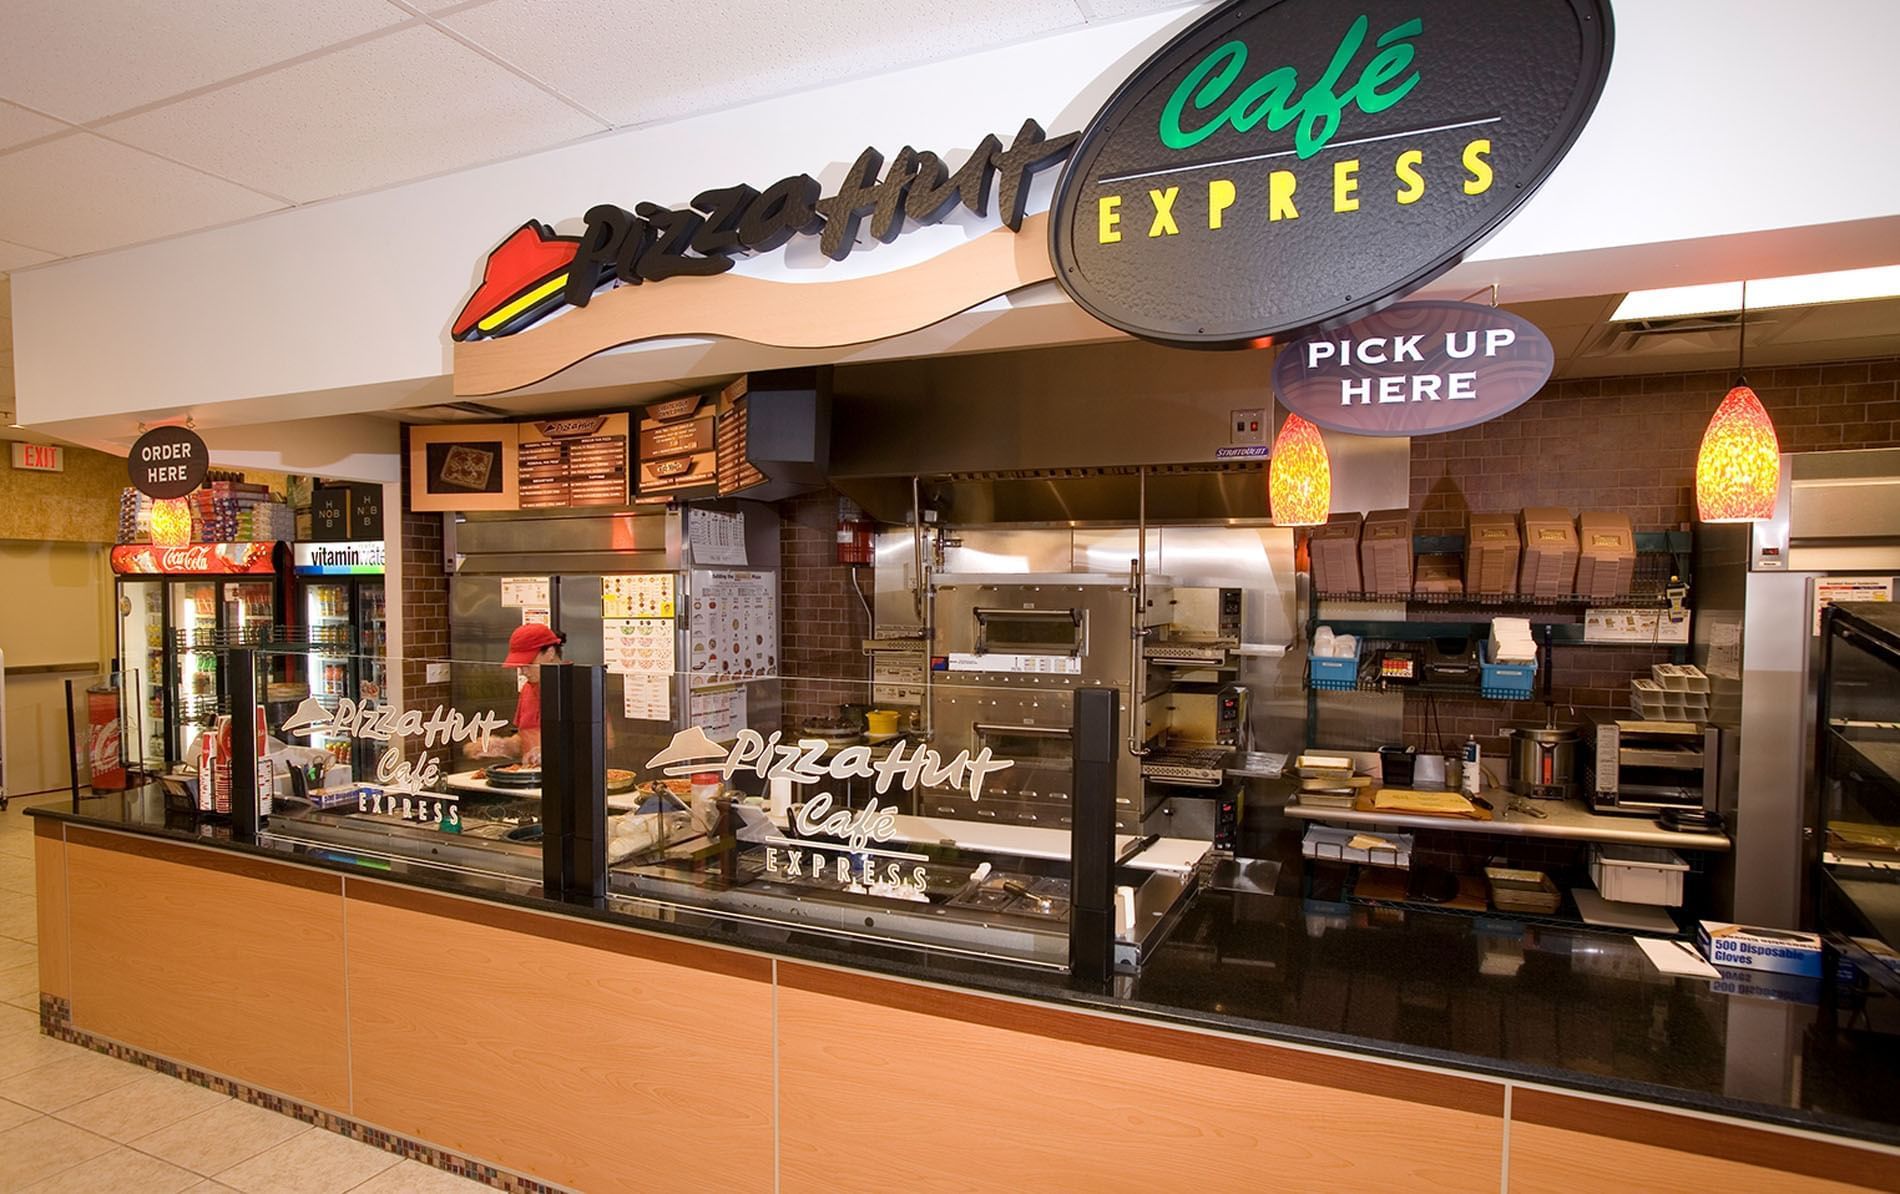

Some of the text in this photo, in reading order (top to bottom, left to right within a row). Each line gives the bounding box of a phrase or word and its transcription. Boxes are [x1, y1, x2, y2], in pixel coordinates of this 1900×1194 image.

[1159, 14, 1424, 160] Café
[564, 118, 1082, 307] Pizza Hut
[1098, 139, 1495, 244] EXPRESS
[1307, 328, 1516, 369] PICK UP
[1340, 371, 1478, 406] HERE
[24, 444, 57, 469] EXIT
[142, 442, 191, 462] ORDER
[148, 465, 188, 483] HERE
[331, 697, 508, 753] Pizza Hut
[376, 747, 441, 796] Café
[724, 728, 1014, 801] Pizza Hut
[358, 791, 460, 826] EXPRESS
[796, 791, 897, 852] Café
[765, 847, 928, 894] EXPRESS
[1714, 950, 1753, 965] Gloves
[1715, 938, 1738, 952] 500
[1740, 941, 1805, 961] Disposable
